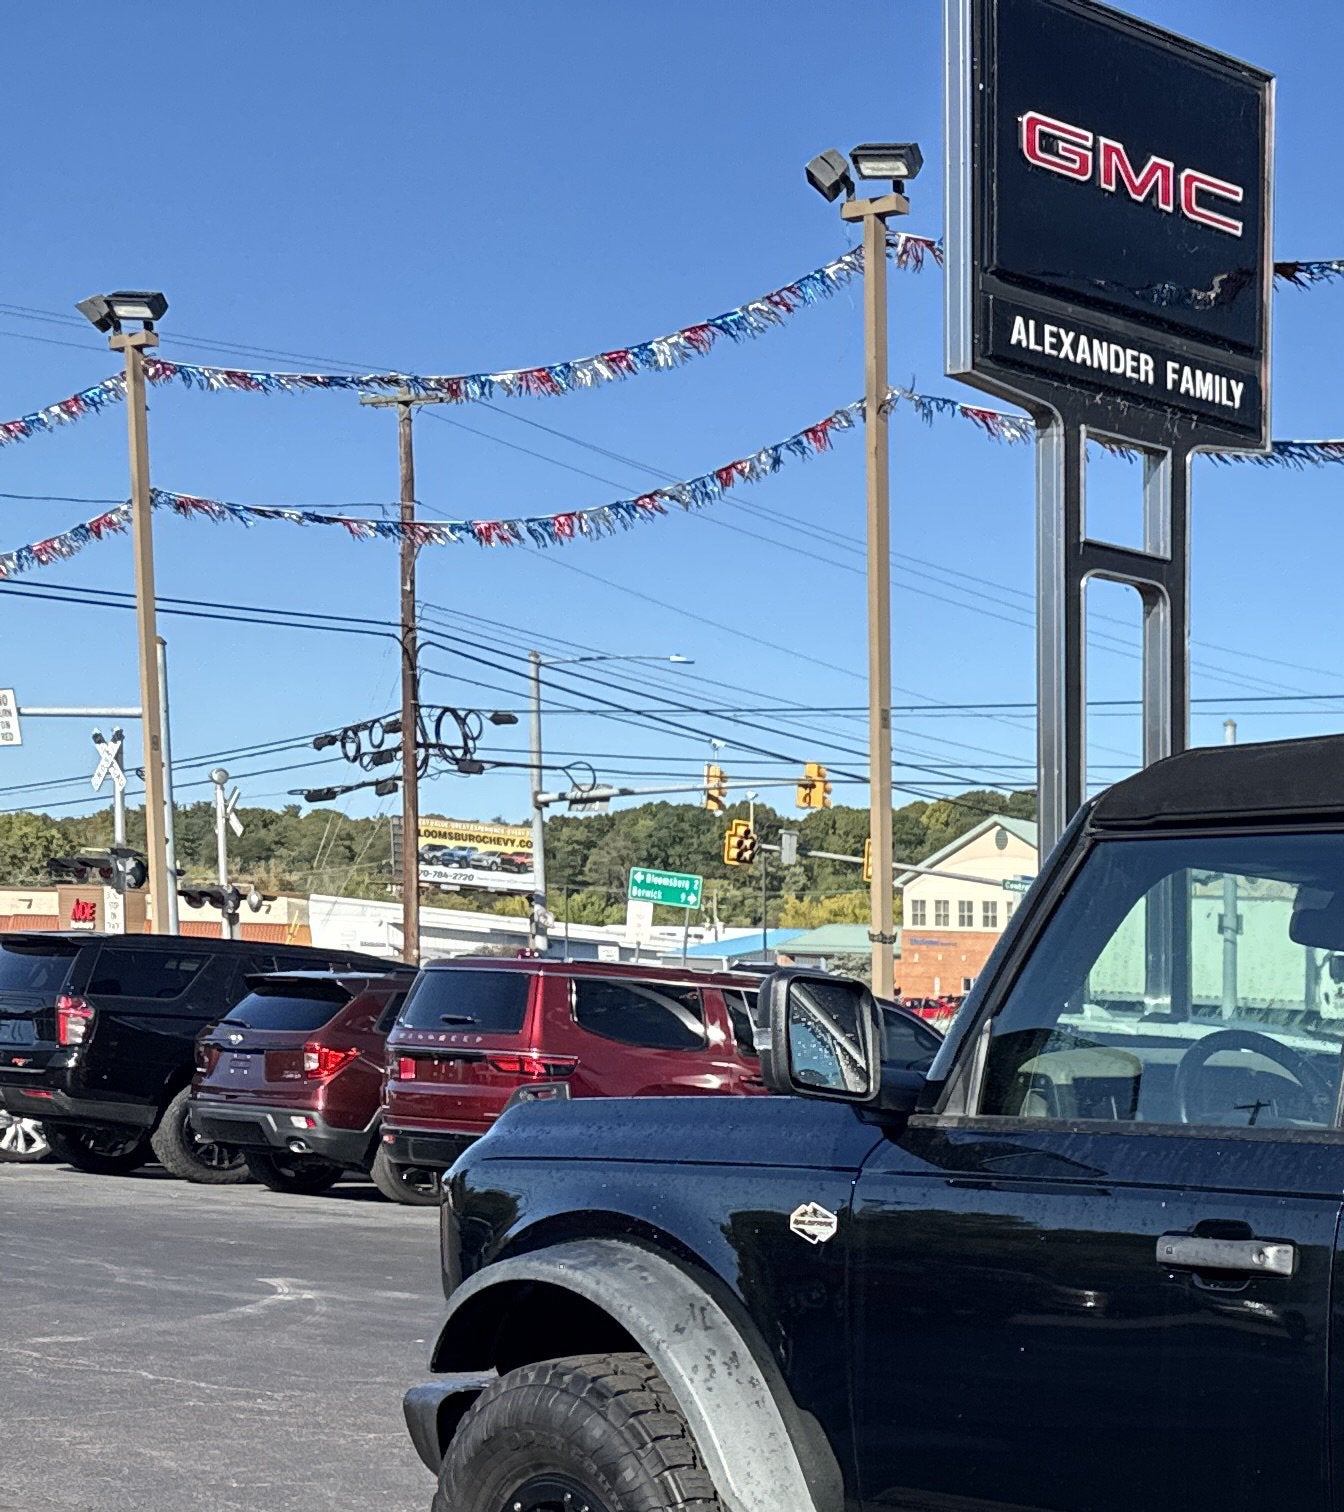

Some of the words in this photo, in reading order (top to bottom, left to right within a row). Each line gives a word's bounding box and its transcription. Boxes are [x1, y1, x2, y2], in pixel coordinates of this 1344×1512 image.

[1022, 111, 1243, 237] GMC
[1010, 316, 1154, 384] ALEXANDER
[1166, 361, 1244, 409] FAMILY
[418, 829, 533, 849] LOOMSBURGCHEVY.CO
[418, 869, 475, 882] 70-784-2720
[646, 873, 690, 890] Bloomsburg
